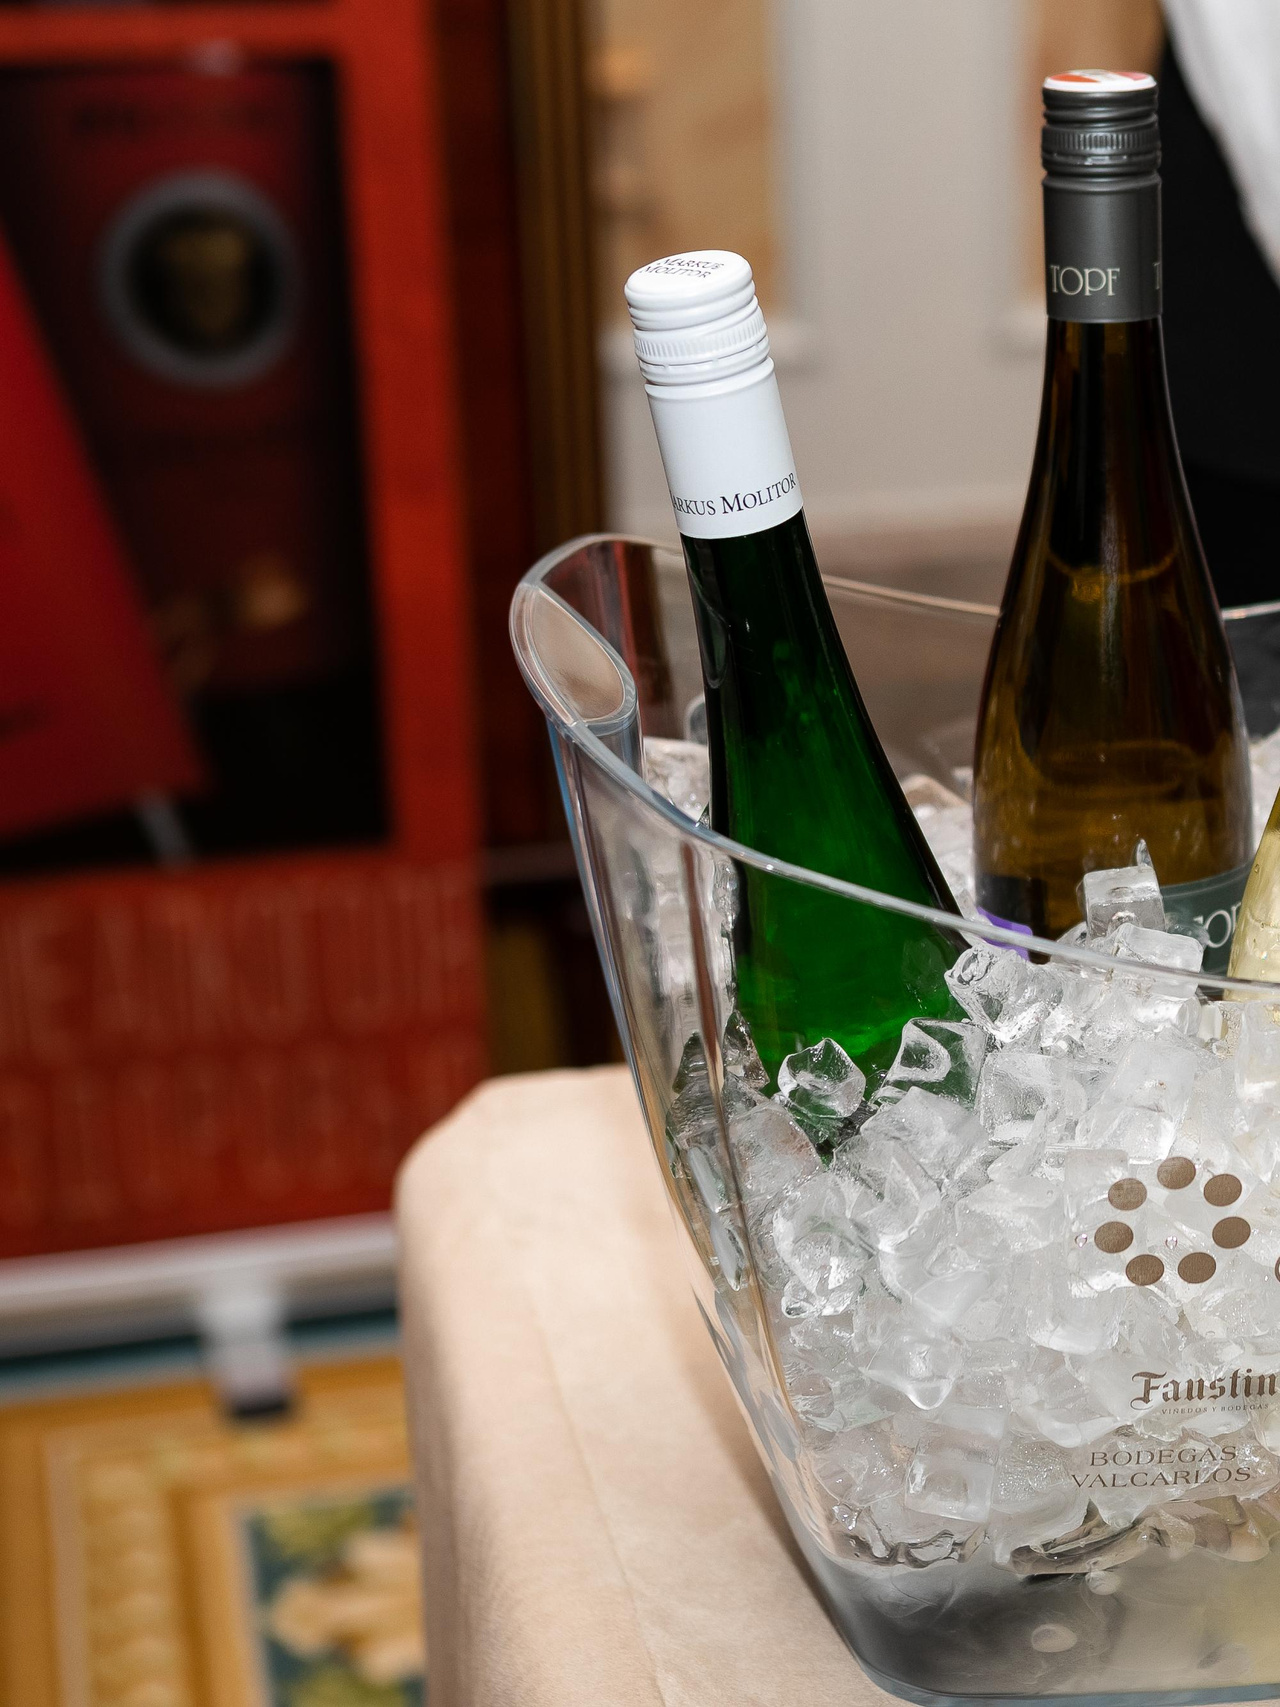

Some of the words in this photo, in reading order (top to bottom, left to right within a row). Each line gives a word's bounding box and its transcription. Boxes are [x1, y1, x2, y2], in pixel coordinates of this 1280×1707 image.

[639, 265, 712, 279] MOLITOR
[1050, 265, 1121, 296] TOPF
[671, 494, 716, 516] ARKUS
[719, 472, 797, 515] MOLITOR
[1220, 1403, 1269, 1413] BODEGAS
[1090, 1446, 1237, 1467] BODEGAS
[1071, 1467, 1251, 1489] VALCARLOS
